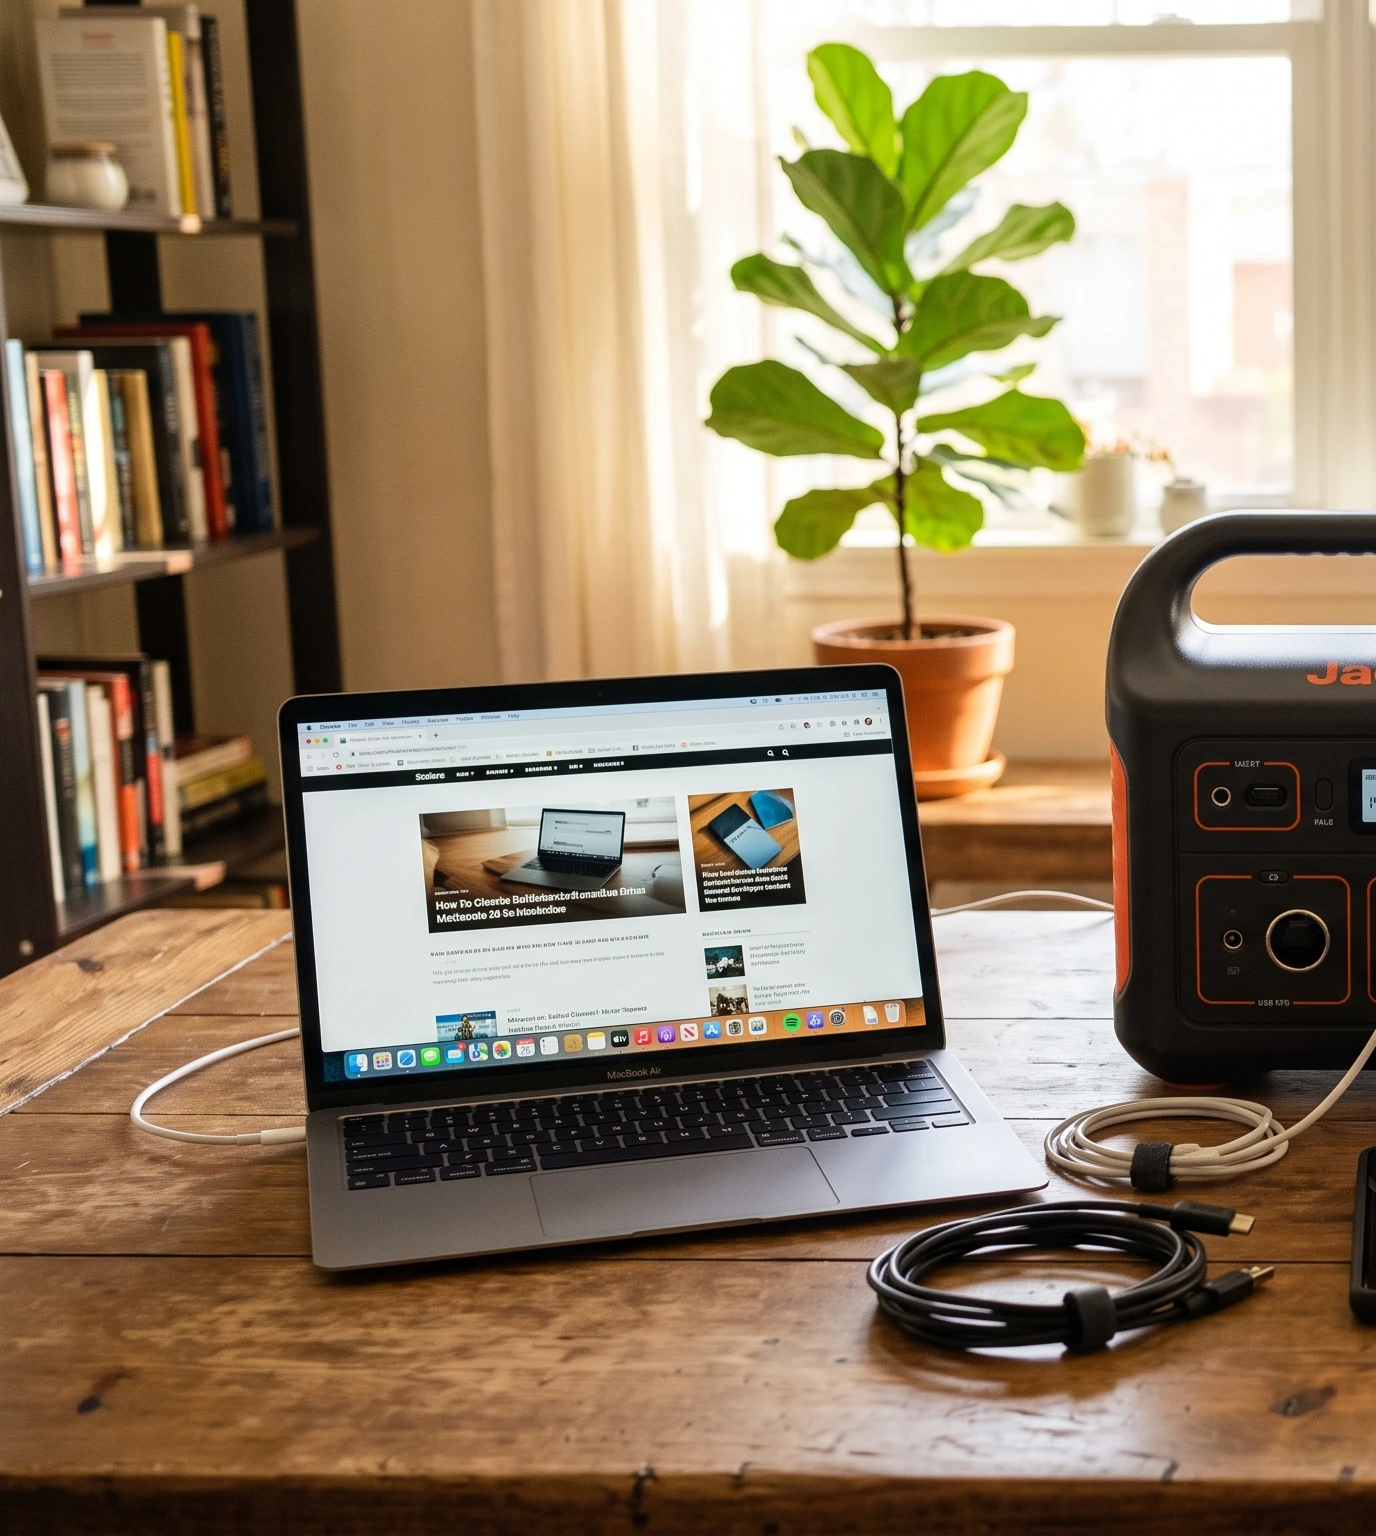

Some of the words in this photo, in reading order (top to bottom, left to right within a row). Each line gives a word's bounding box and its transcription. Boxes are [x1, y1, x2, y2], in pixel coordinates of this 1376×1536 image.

[435, 900, 457, 911] How
[1257, 999, 1274, 1007] USB
[520, 1045, 531, 1055] 26
